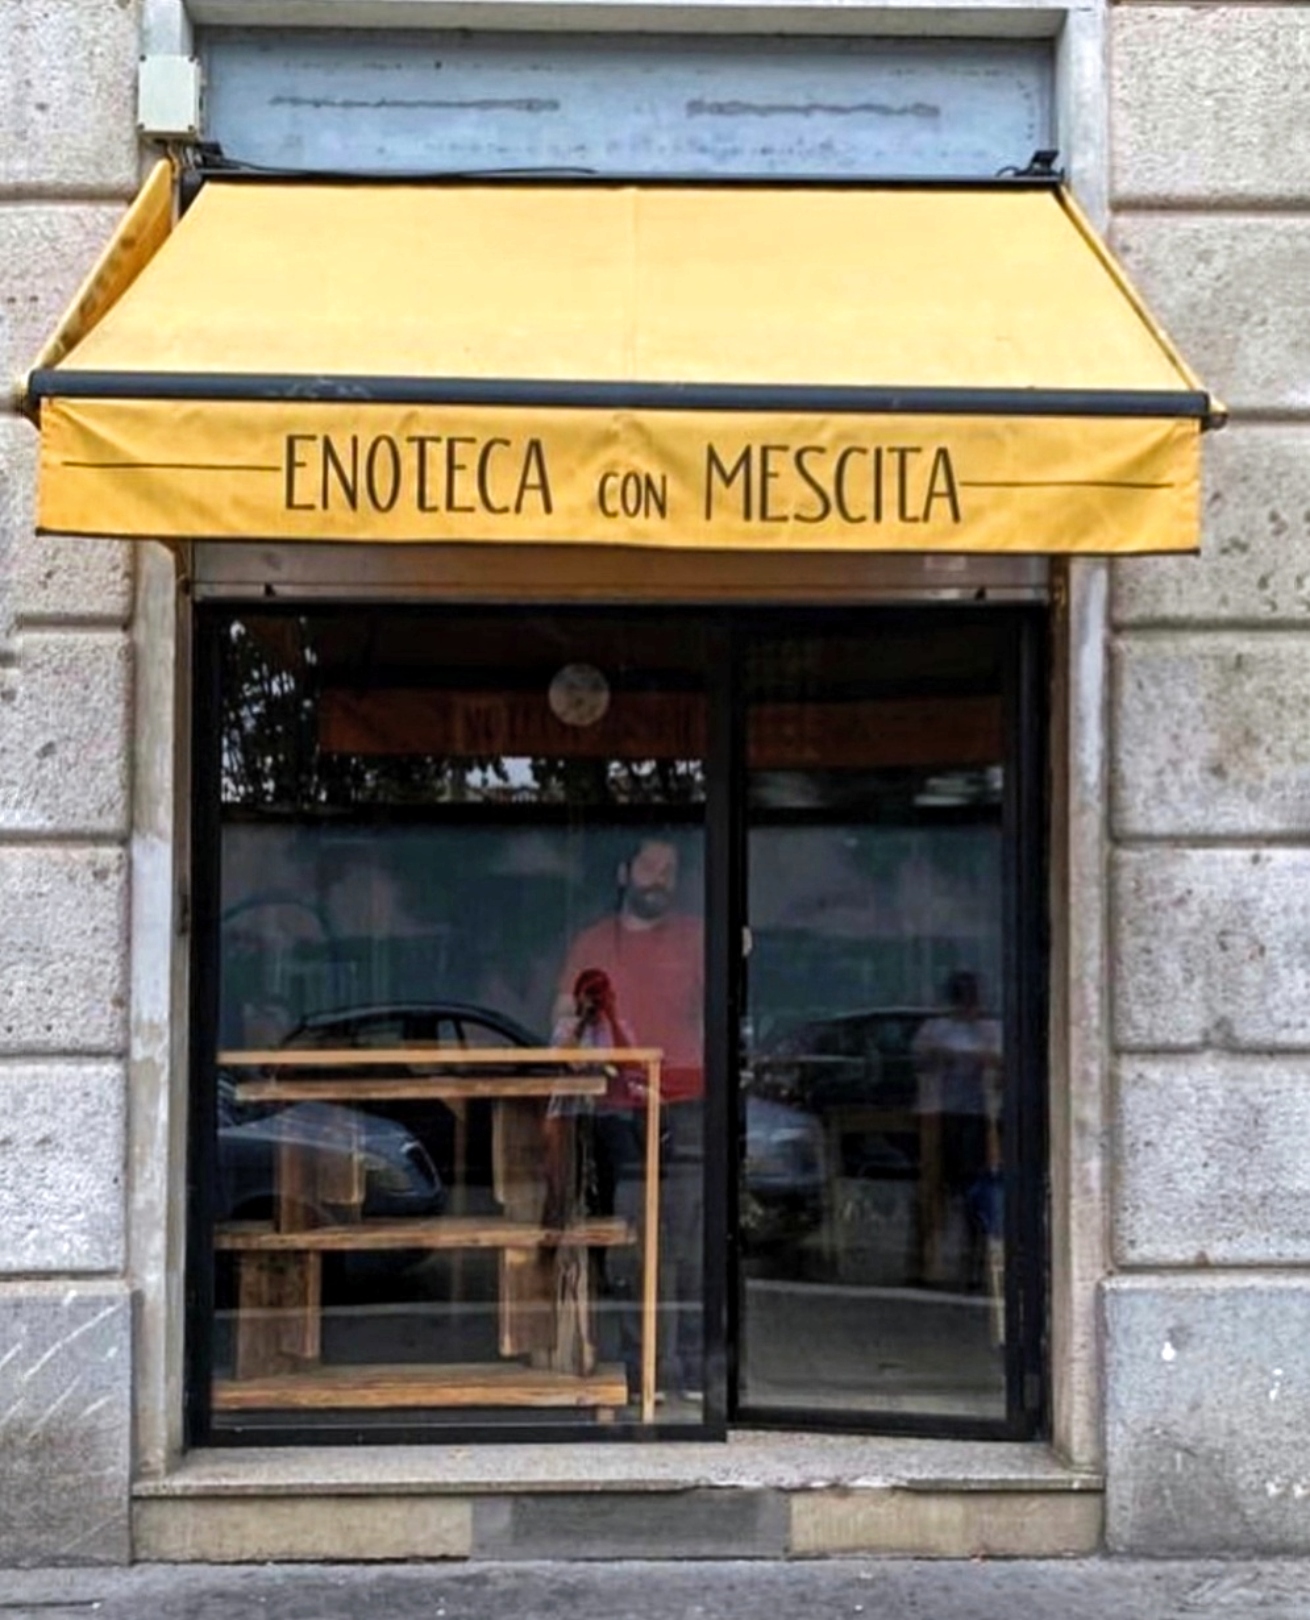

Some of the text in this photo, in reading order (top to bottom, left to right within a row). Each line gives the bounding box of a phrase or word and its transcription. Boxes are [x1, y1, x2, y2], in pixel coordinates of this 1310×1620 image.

[284, 433, 961, 524] ENOTECA CON MESCITA
